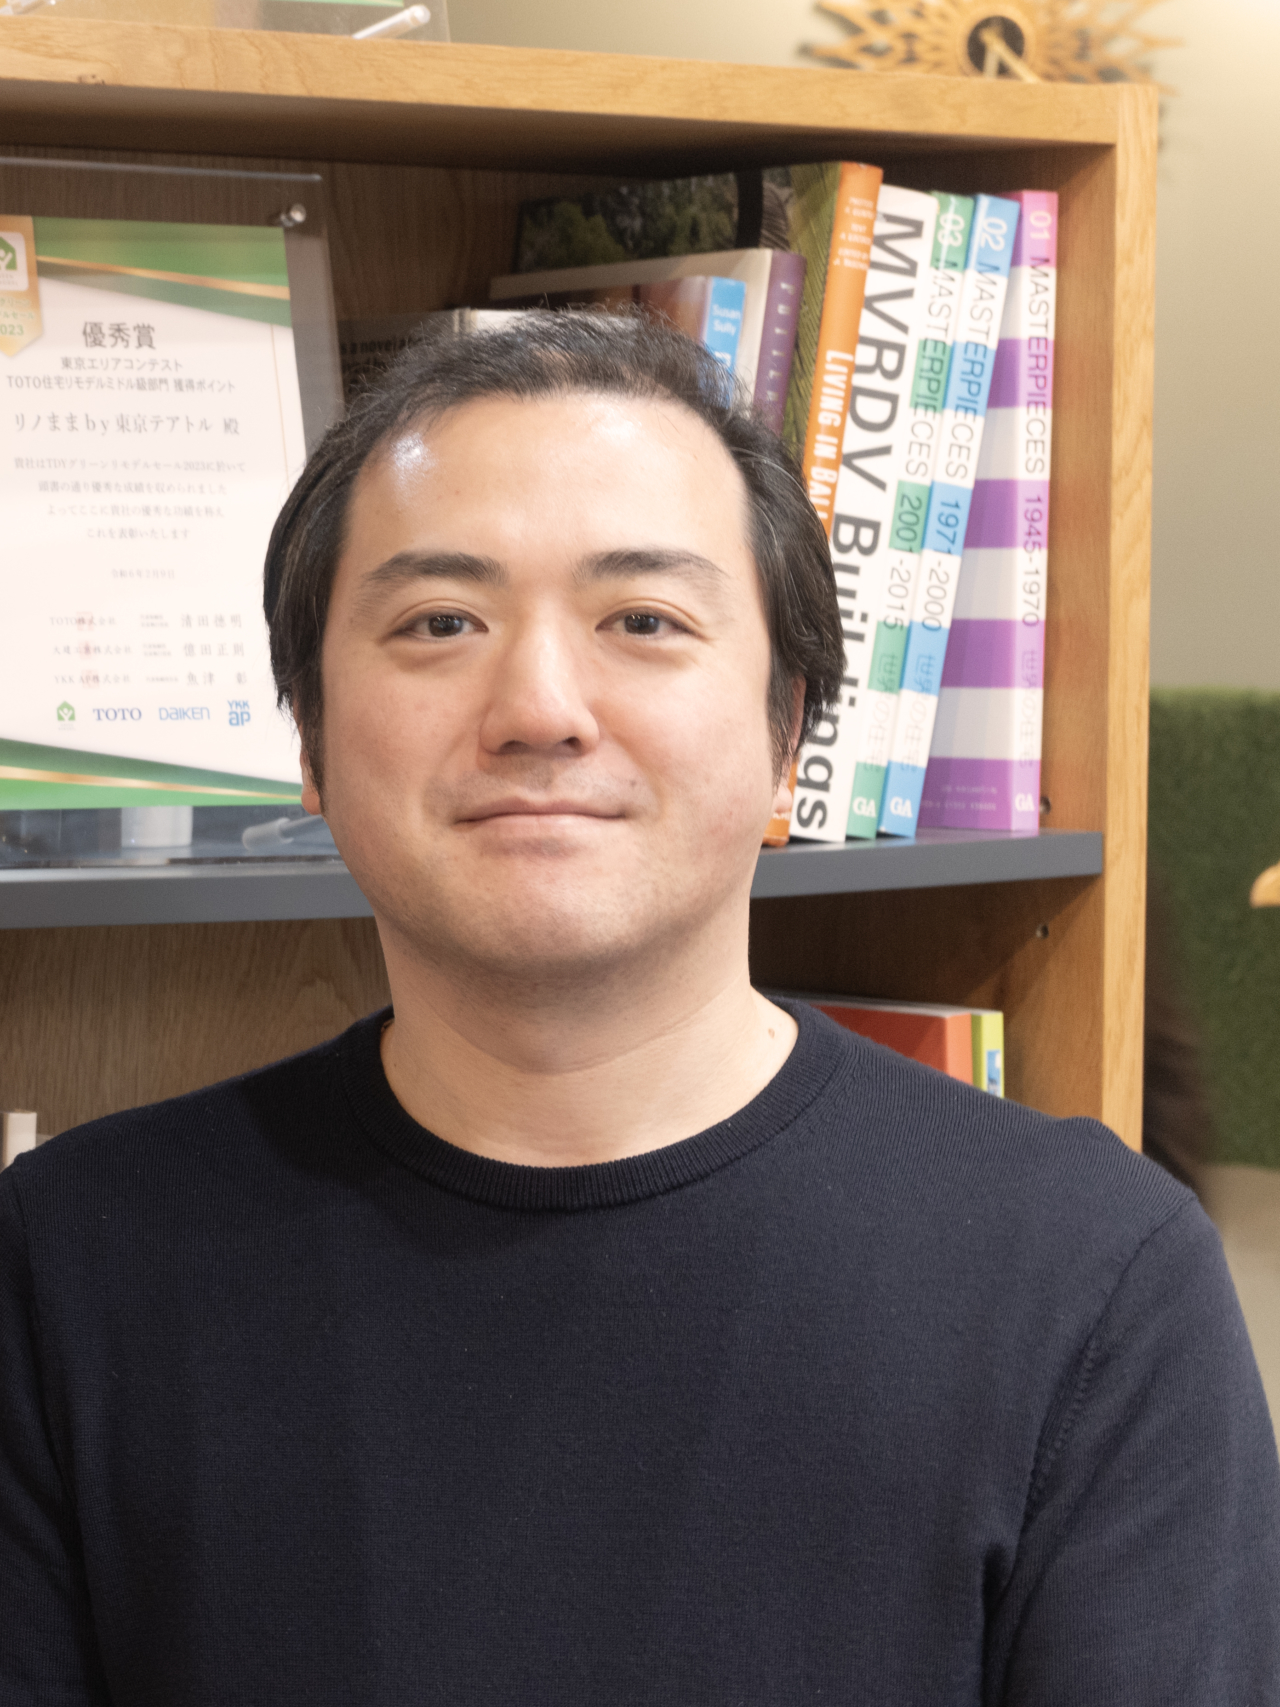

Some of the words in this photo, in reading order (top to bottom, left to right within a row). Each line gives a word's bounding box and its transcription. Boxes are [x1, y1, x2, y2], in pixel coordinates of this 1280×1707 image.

[935, 212, 966, 248] 03
[979, 217, 1008, 252] 02
[1029, 210, 1053, 241] 01
[82, 321, 157, 350] 優秀賞
[60, 357, 184, 372] 東京エリアコンテスト
[841, 211, 925, 493] MVRDV
[1024, 255, 1051, 475] MASTERPIECES
[905, 257, 960, 479] MASTERPIECES
[945, 260, 1001, 480] MASTERPIECES
[6, 375, 170, 392] TOTO住宅リモデルミドル級部門
[174, 379, 236, 394] 獲得ポイント
[816, 350, 855, 428] LIVING
[223, 417, 241, 436] 殿
[812, 434, 839, 460] IN
[883, 493, 924, 632] 2001-2015
[921, 499, 962, 632] 1971-2000
[1022, 495, 1044, 627] 1945-1970
[92, 706, 143, 722] TOTO
[227, 700, 251, 711] YKK
[852, 796, 877, 818] GA
[889, 796, 914, 818] GA
[1015, 793, 1035, 812] GA
